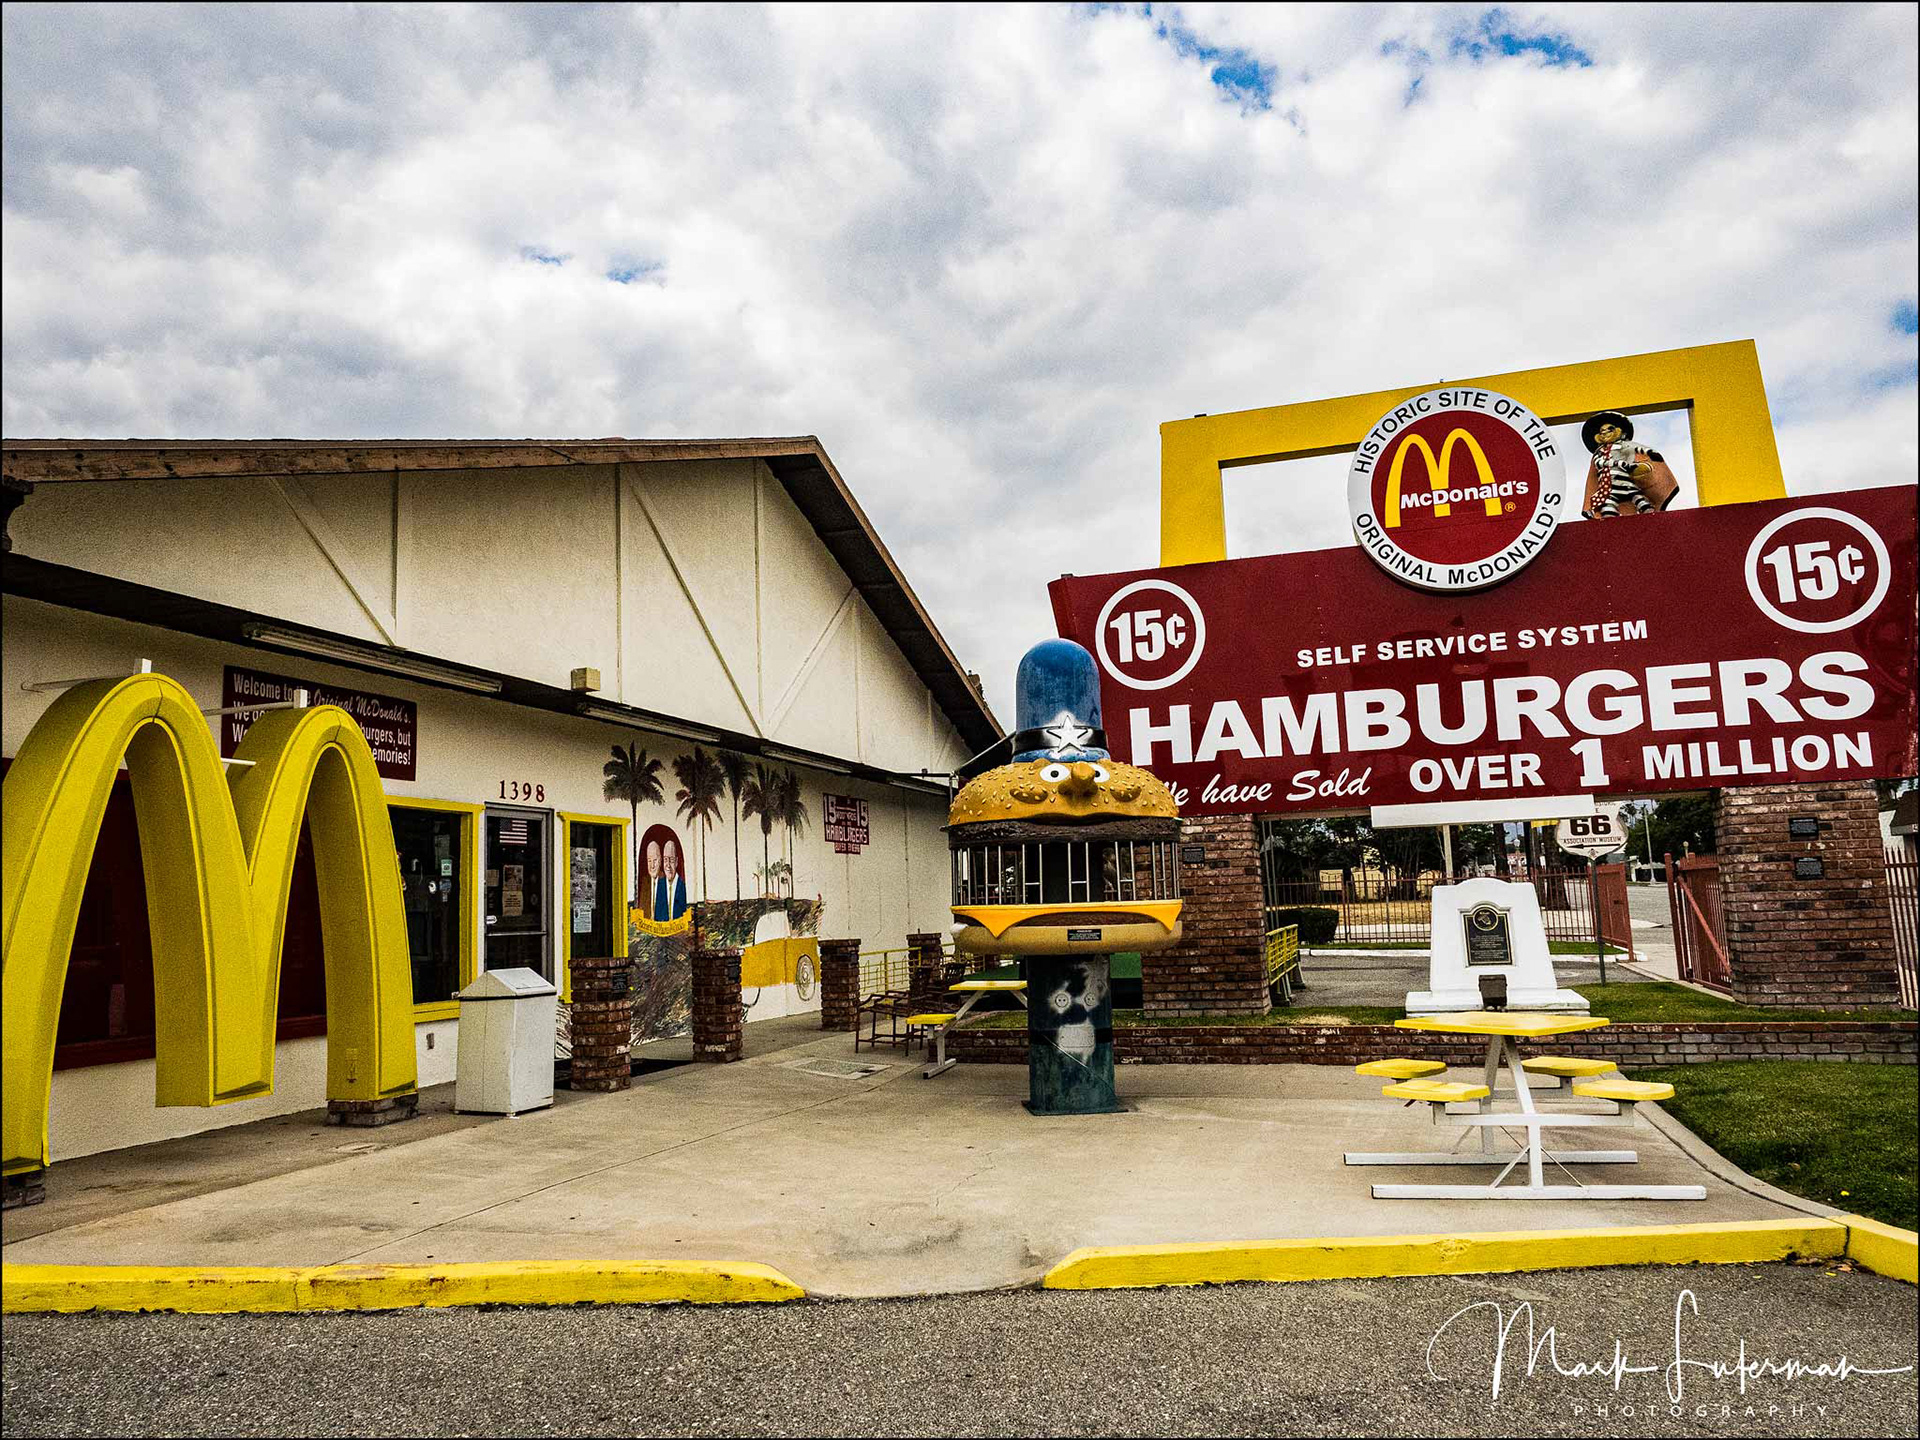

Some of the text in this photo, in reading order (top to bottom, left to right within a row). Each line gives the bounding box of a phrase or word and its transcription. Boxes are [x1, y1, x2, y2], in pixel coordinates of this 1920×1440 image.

[1354, 390, 1556, 474] HISTORIC SITE OF THE
[1400, 479, 1529, 510] McDonald's
[1356, 492, 1562, 585] ORIGINAL McDONALD'S
[1762, 540, 1866, 605] 15¢
[1109, 608, 1187, 664] 15¢
[1297, 619, 1649, 668] SELF SERVICE SYSTEM
[233, 673, 281, 700] Welcome
[283, 683, 293, 701] to
[1129, 651, 1876, 767] HAMBURGERS
[232, 722, 249, 742] W
[397, 728, 411, 747] but
[372, 747, 411, 766] emories!
[1201, 773, 1273, 804] have
[1286, 766, 1372, 801] Sold
[1409, 753, 1545, 793] OVER
[1569, 738, 1610, 787] 1
[1642, 731, 1874, 781] MILLION
[500, 780, 546, 803] 1398
[1563, 837, 1597, 845] ASSOCIATION
[1570, 815, 1611, 836] 66
